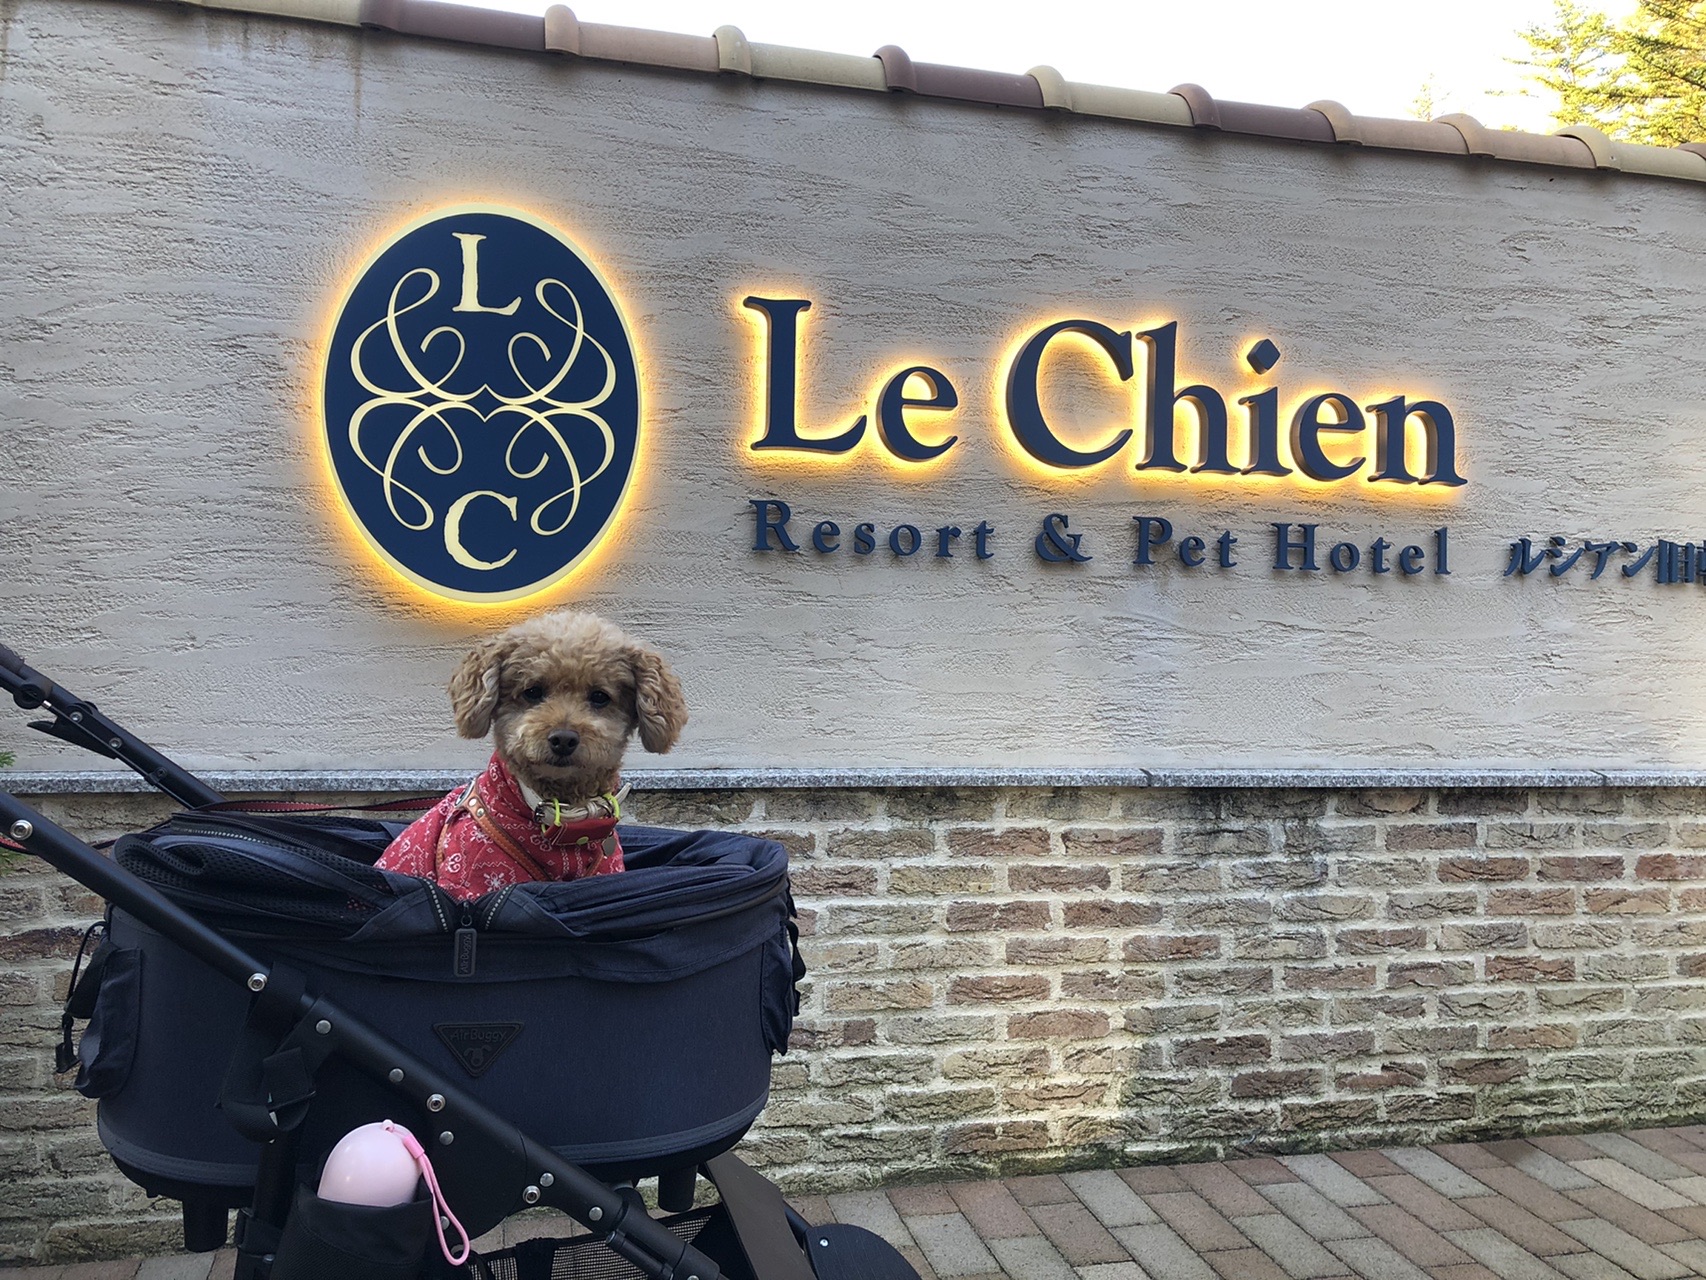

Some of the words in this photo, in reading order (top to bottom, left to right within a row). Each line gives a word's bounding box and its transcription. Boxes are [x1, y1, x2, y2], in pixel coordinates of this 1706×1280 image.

[452, 232, 522, 316] L
[743, 295, 959, 463] Le
[1005, 318, 1469, 488] Chien
[444, 490, 518, 571] C
[749, 499, 996, 561] Resort
[1034, 513, 1094, 564] &
[1132, 515, 1239, 569] Pet
[1271, 522, 1453, 577] Hotel
